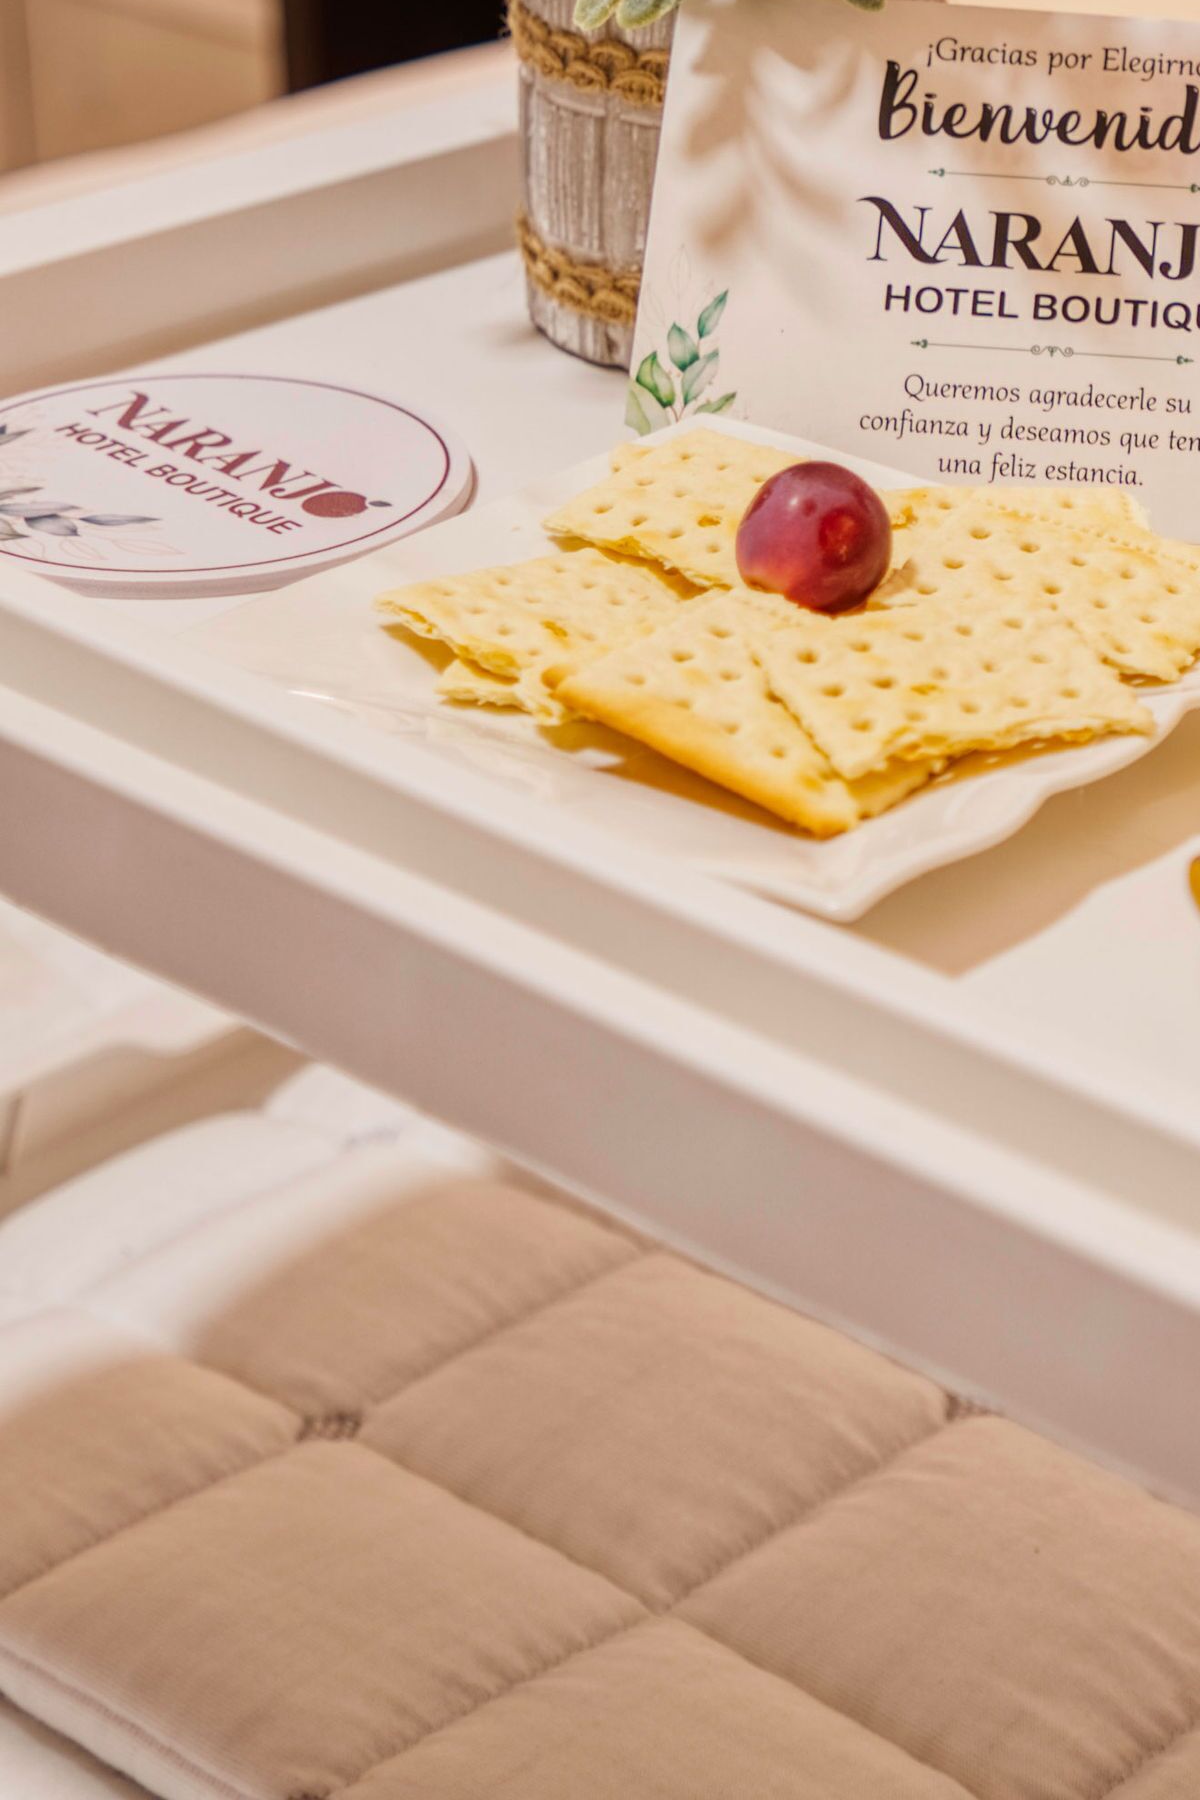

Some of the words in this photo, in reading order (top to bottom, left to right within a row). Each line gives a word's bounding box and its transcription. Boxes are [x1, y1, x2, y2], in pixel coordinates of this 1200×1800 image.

[927, 37, 1037, 67] ¡Gracias
[1048, 50, 1093, 74] por
[884, 284, 1018, 319] HOTEL
[903, 374, 1020, 403] Queremos
[1029, 382, 1156, 412] agradecerle
[1166, 393, 1191, 413] su
[859, 409, 968, 440] confianza
[978, 421, 991, 445] y
[1001, 417, 1111, 447] deseamos
[1120, 428, 1159, 454] que
[86, 390, 369, 518] NARANJO
[938, 456, 981, 476] una
[988, 450, 1037, 483] feliz
[1045, 457, 1144, 487] estancia.
[55, 423, 150, 467] HOTEL
[145, 464, 303, 535] BOUTIQUE
